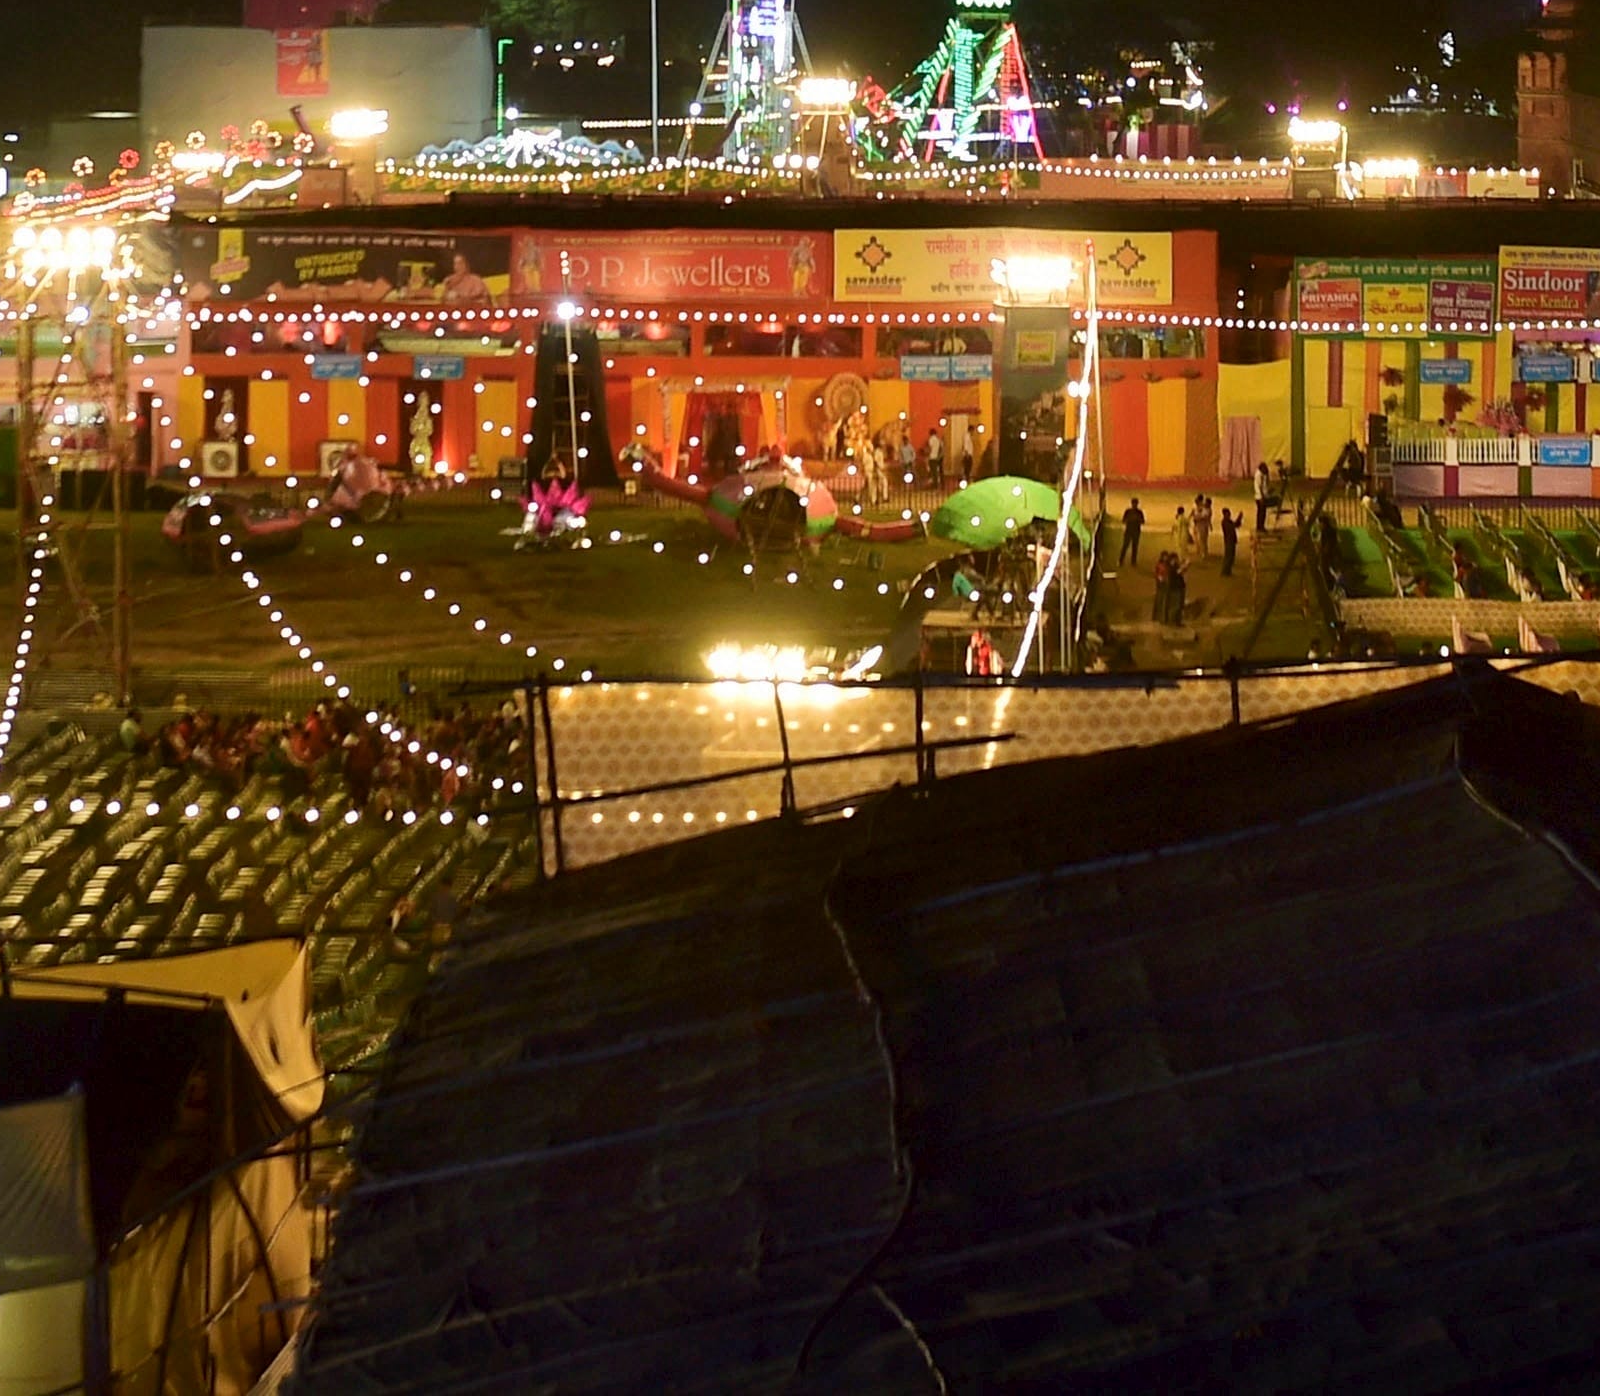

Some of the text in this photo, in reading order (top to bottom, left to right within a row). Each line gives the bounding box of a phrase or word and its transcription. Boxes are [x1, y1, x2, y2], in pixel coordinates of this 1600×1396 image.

[925, 235, 967, 253] रामलीला
[294, 249, 366, 269] UNTOUCHED
[298, 264, 359, 282] BY HANDS
[634, 254, 772, 288] Jewellers
[846, 275, 901, 285] sawasdee
[1504, 269, 1584, 292] Sindoor
[1301, 292, 1359, 303] PRIYANKA
[1507, 293, 1580, 309] Saree Kendra
